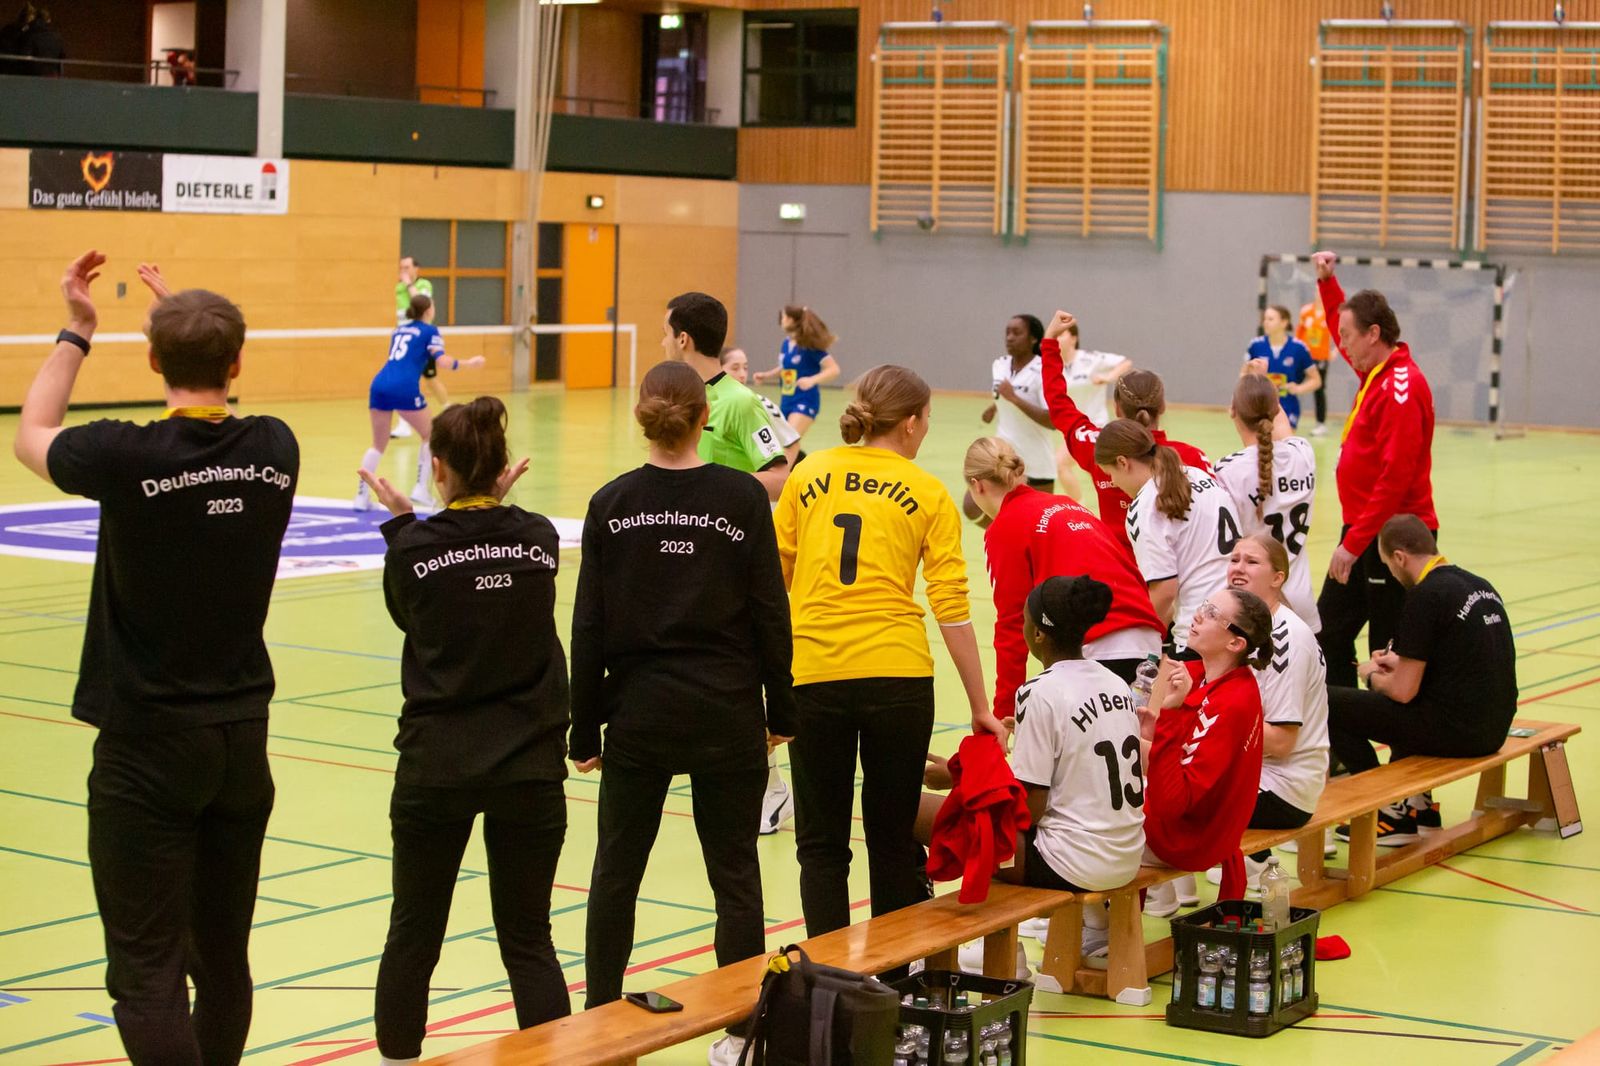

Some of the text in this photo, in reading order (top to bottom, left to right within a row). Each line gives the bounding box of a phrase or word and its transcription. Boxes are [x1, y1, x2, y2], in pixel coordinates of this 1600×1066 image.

[33, 188, 55, 205] Das
[57, 192, 83, 209] gute
[85, 190, 122, 210] Gefühl
[176, 182, 253, 200] DIETERLE
[389, 334, 413, 361] 15
[141, 464, 291, 498] Deutschland-Cup
[800, 472, 919, 515] HV Berlin
[1278, 472, 1315, 493] Berli
[206, 498, 244, 515] 2023
[608, 510, 745, 542] Deutschland-Cup
[1066, 520, 1094, 532] Berlin
[660, 539, 694, 554] 2023
[833, 513, 862, 586] 1
[413, 543, 556, 579] Deutschland-Cup
[475, 573, 512, 590] 2023
[1071, 697, 1098, 733] HV
[1094, 734, 1144, 811] 13
